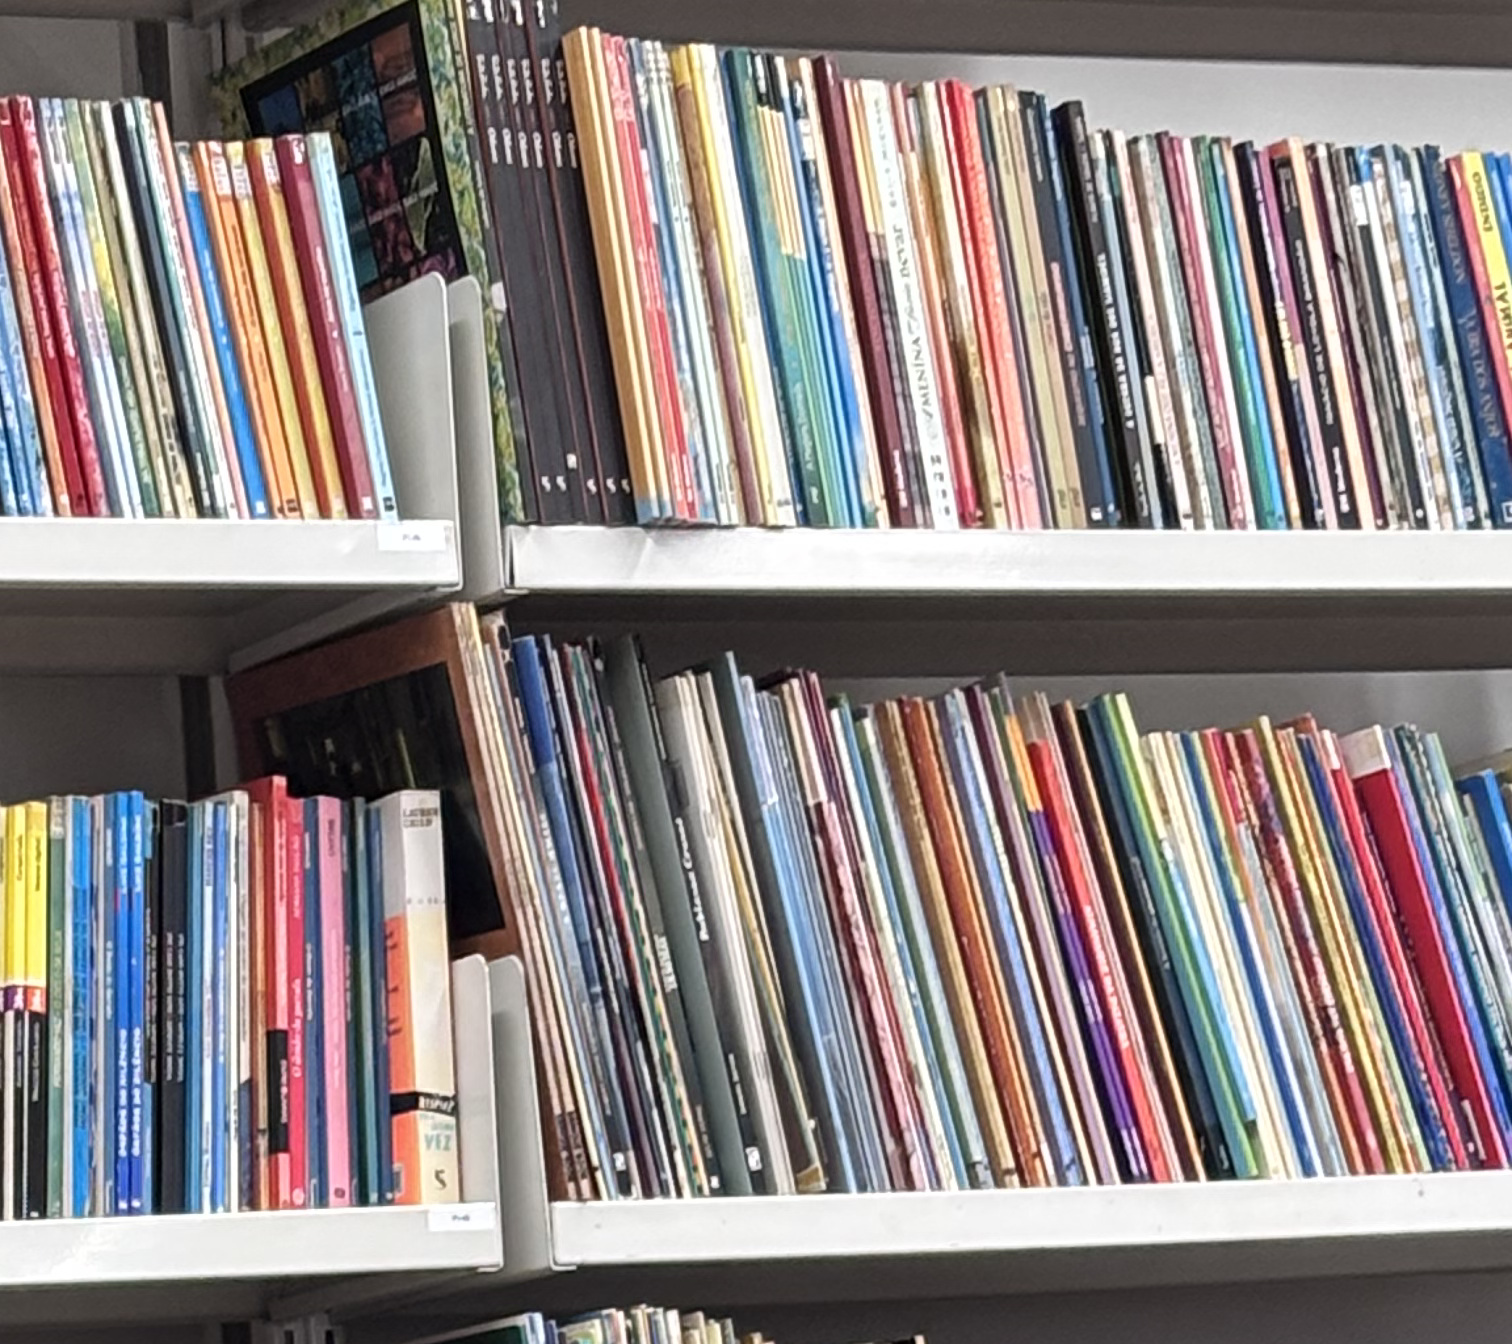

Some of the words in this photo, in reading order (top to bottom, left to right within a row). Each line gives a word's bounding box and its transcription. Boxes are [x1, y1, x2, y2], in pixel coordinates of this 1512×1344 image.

[674, 816, 698, 869] Crusoé
[685, 871, 710, 942] Robinson
[424, 1134, 452, 1152] VEZ
